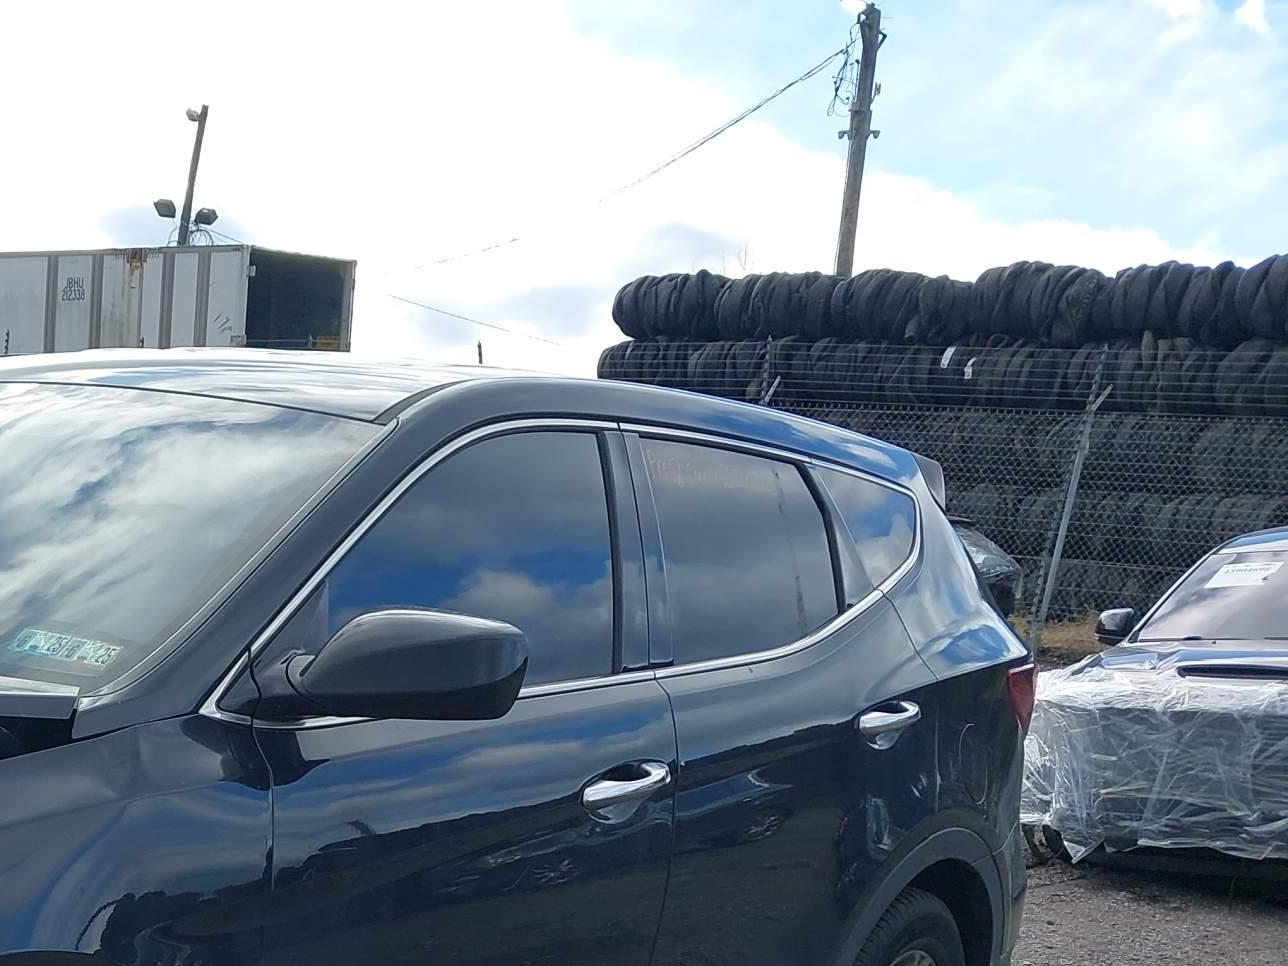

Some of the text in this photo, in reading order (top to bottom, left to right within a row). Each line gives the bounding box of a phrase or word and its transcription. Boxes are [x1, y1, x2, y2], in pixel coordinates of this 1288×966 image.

[65, 277, 84, 289] JBHU
[47, 636, 68, 652] 25
[95, 647, 118, 664] 25
